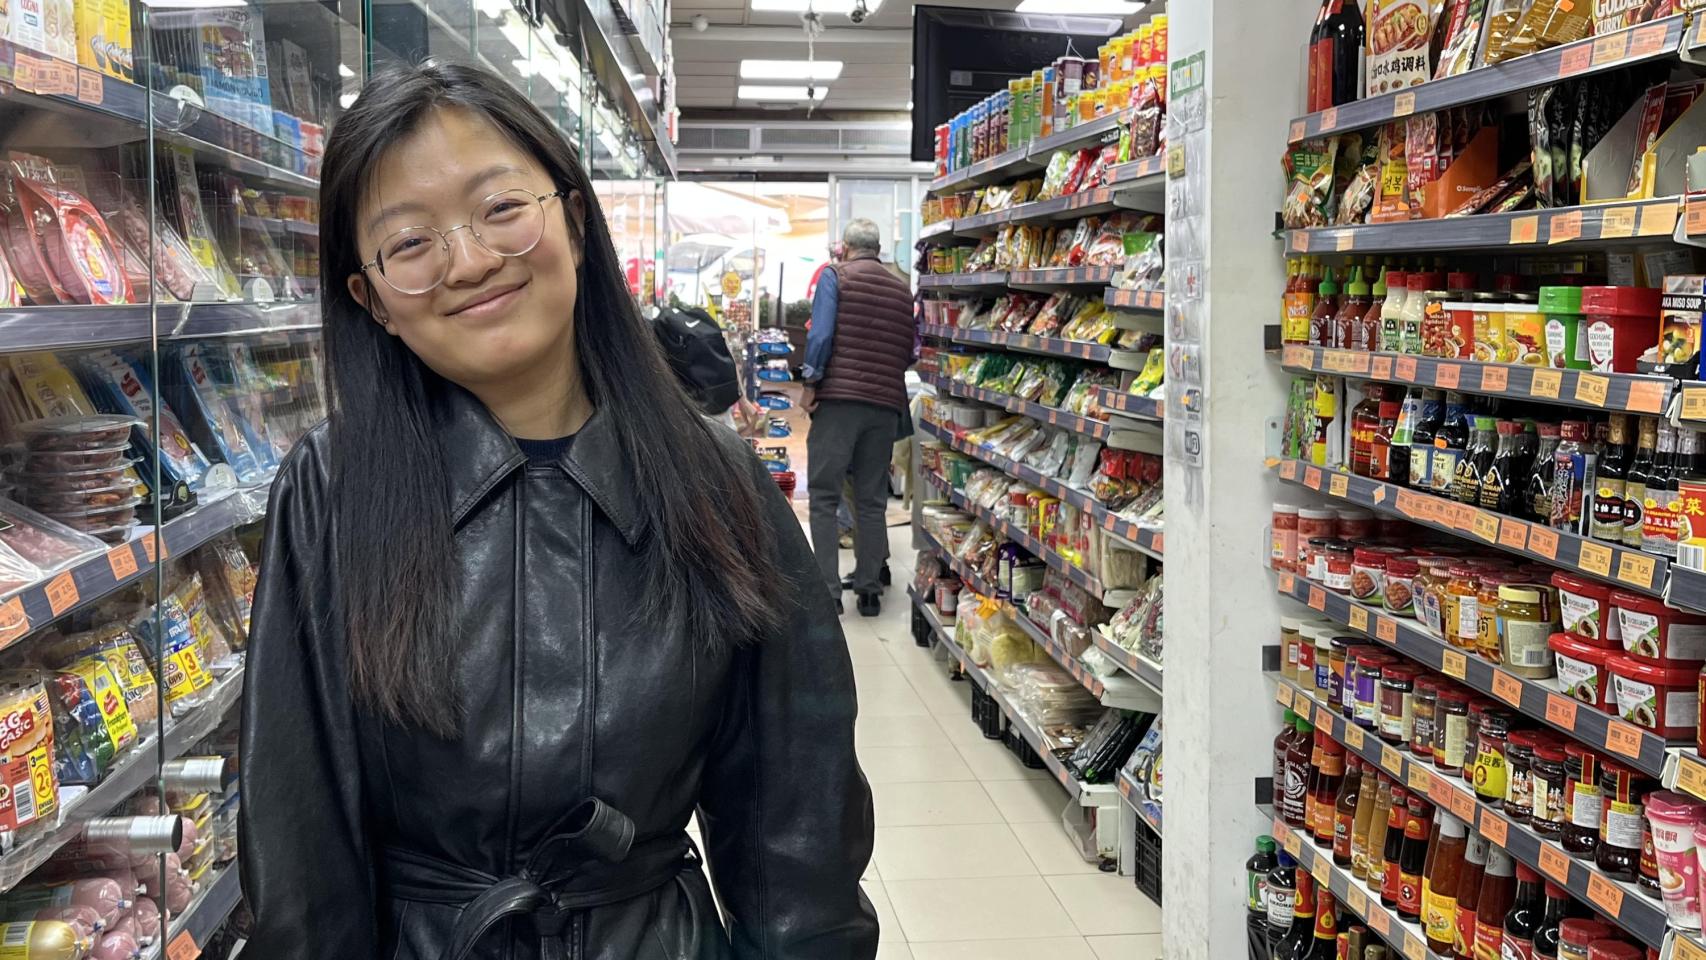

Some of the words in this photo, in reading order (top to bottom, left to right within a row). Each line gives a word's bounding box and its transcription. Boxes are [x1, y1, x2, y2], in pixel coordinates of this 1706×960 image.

[1595, 14, 1623, 35] CURRY
[1672, 297, 1685, 309] MISO
[1686, 298, 1702, 310] SOUP
[30, 756, 37, 768] 3
